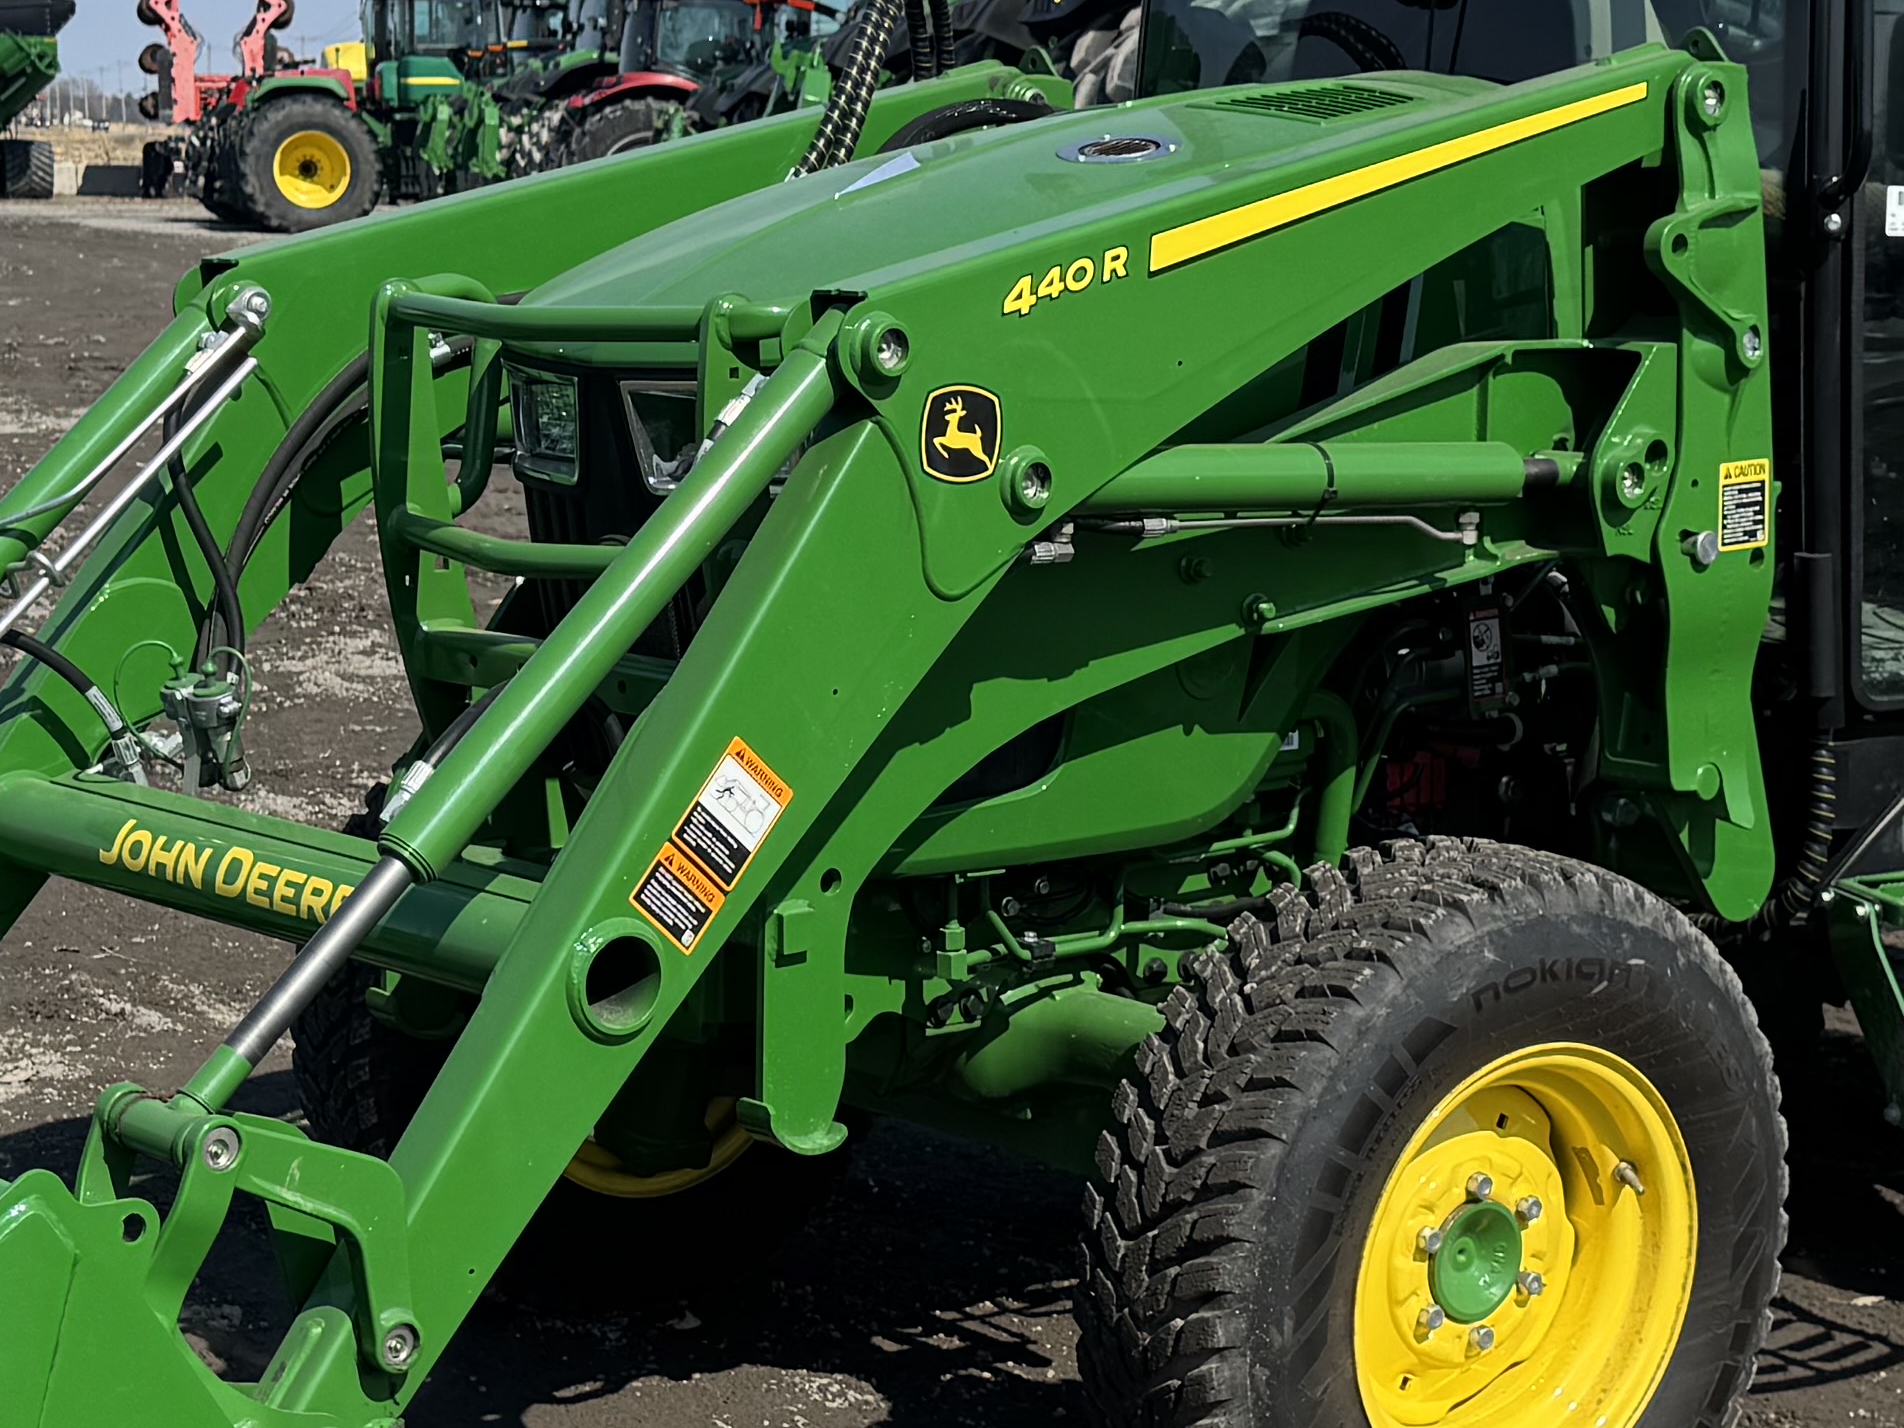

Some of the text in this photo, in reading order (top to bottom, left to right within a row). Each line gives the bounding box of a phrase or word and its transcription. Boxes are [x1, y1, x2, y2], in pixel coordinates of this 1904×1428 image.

[1733, 463, 1766, 479] CAUTION
[745, 756, 784, 799] WARNING
[99, 818, 213, 889] JOHN
[676, 862, 716, 903] WARNING
